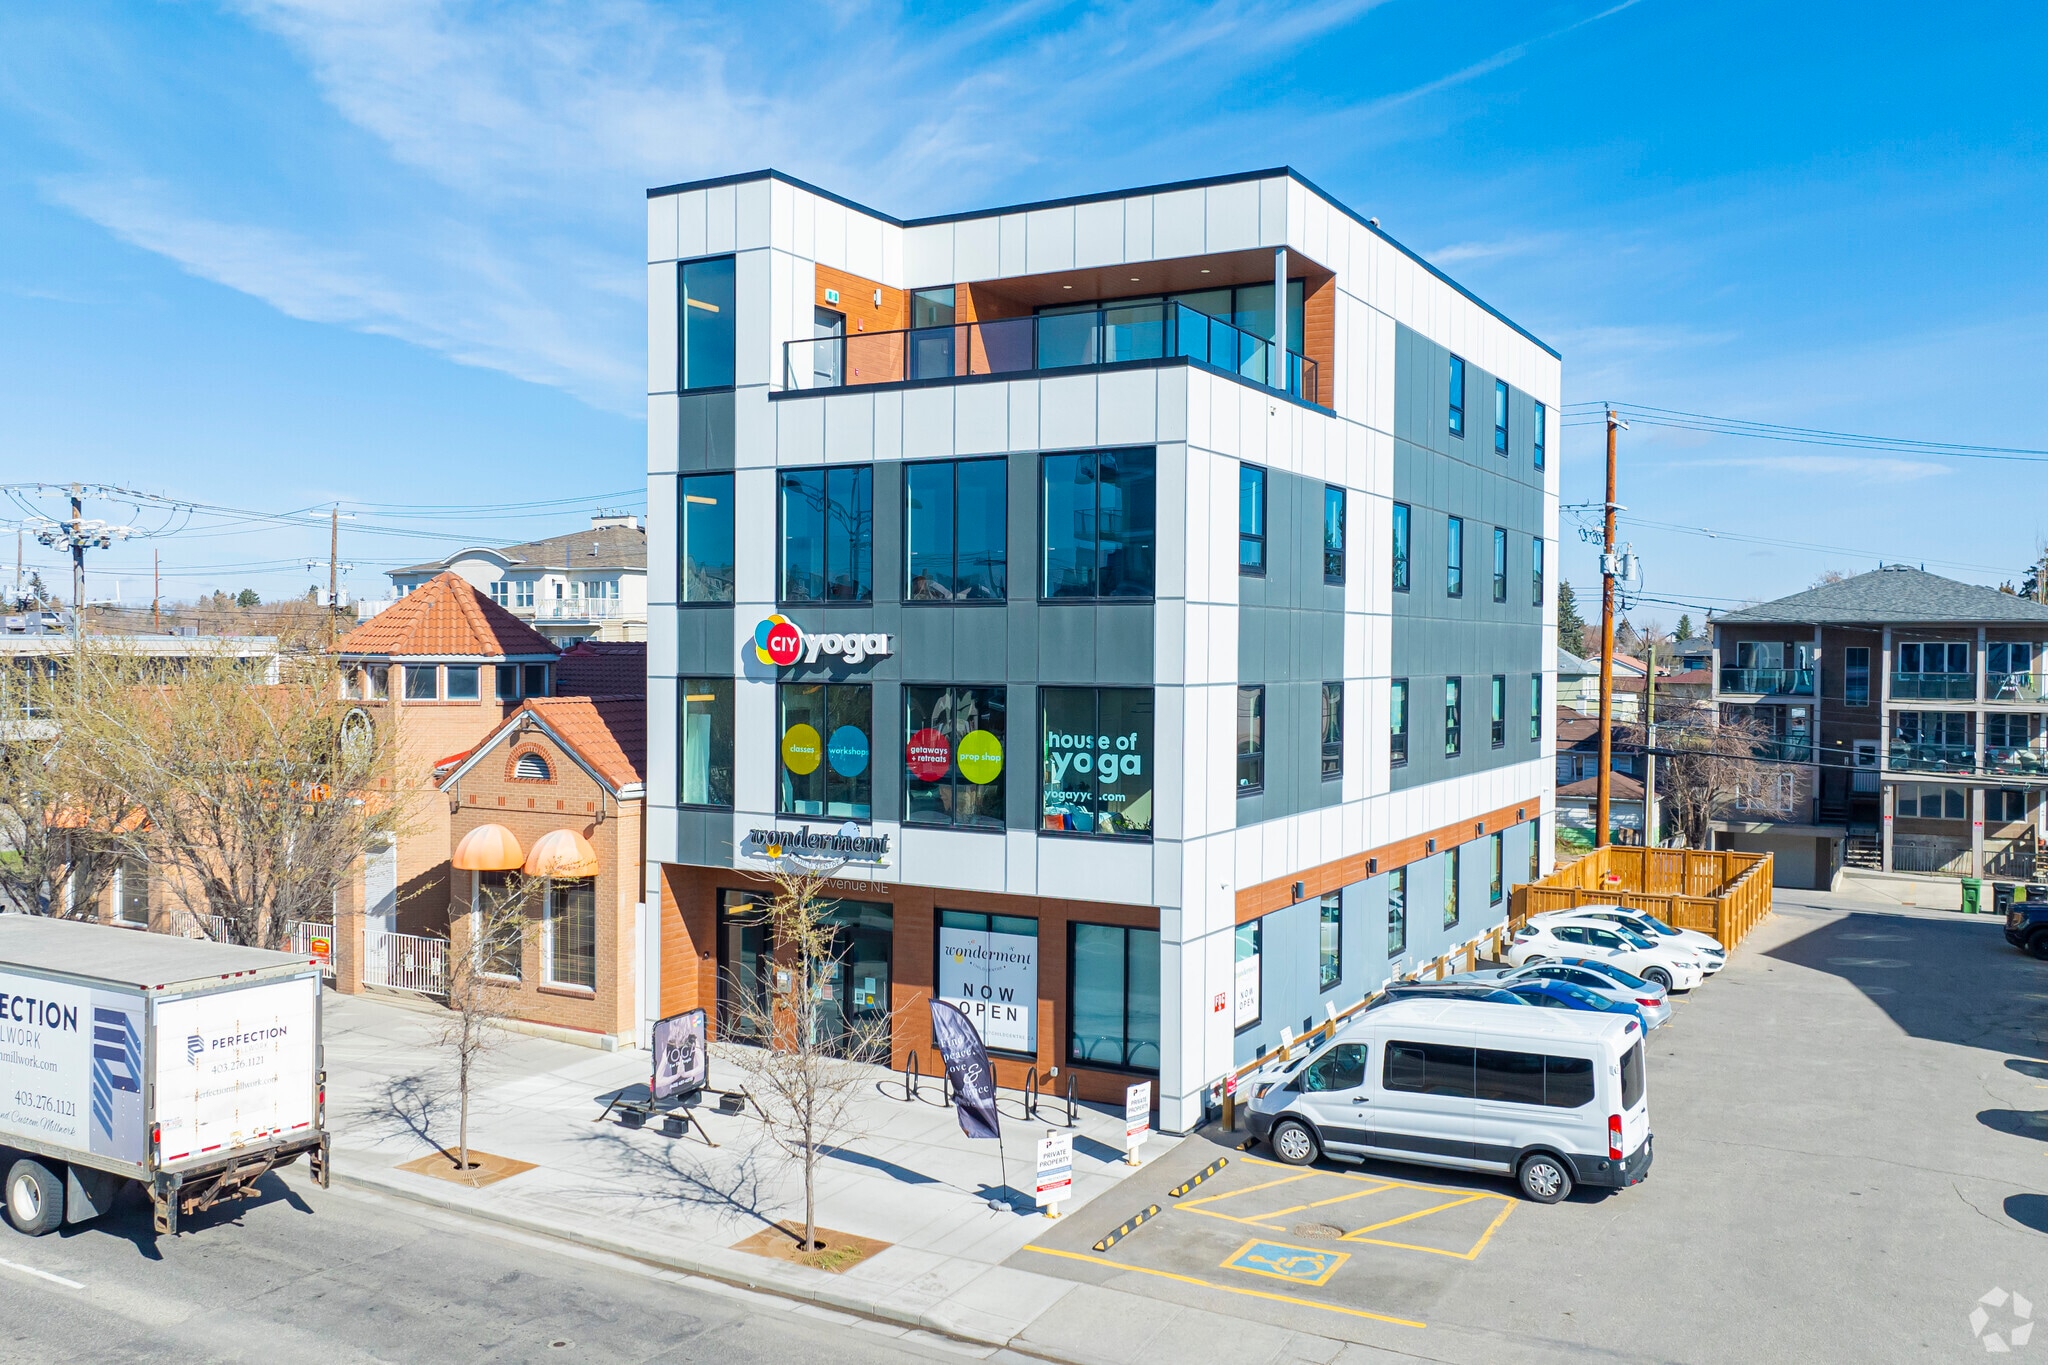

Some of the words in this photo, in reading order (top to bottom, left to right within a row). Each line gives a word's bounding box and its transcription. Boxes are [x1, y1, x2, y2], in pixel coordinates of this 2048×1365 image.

[770, 636, 797, 652] CIY
[803, 633, 888, 664] yoga
[789, 743, 815, 754] classes
[1048, 731, 1110, 750] house
[1116, 732, 1138, 750] of
[828, 746, 869, 758] workshops
[910, 746, 948, 756] getaways
[917, 755, 947, 763] retreats
[960, 753, 979, 763] prop
[981, 752, 1001, 764] shop
[1052, 751, 1141, 784] yoga
[750, 825, 891, 854] wonderment
[822, 877, 867, 893] Avenue
[870, 881, 889, 895] NE
[945, 945, 1031, 965] wonderment
[963, 982, 1014, 1002] NOW
[0, 993, 77, 1033] ECTION
[960, 1001, 1017, 1022] OPEN
[0, 1025, 41, 1050] LWORK
[212, 1026, 287, 1050] PERFECTION
[212, 1056, 264, 1075] 403.276.1121
[949, 1064, 967, 1073] ove
[14, 1090, 77, 1117] 403.276.1121
[1039, 1156, 1070, 1167] PROPERTY
[1043, 1148, 1067, 1159] PRIVATE
